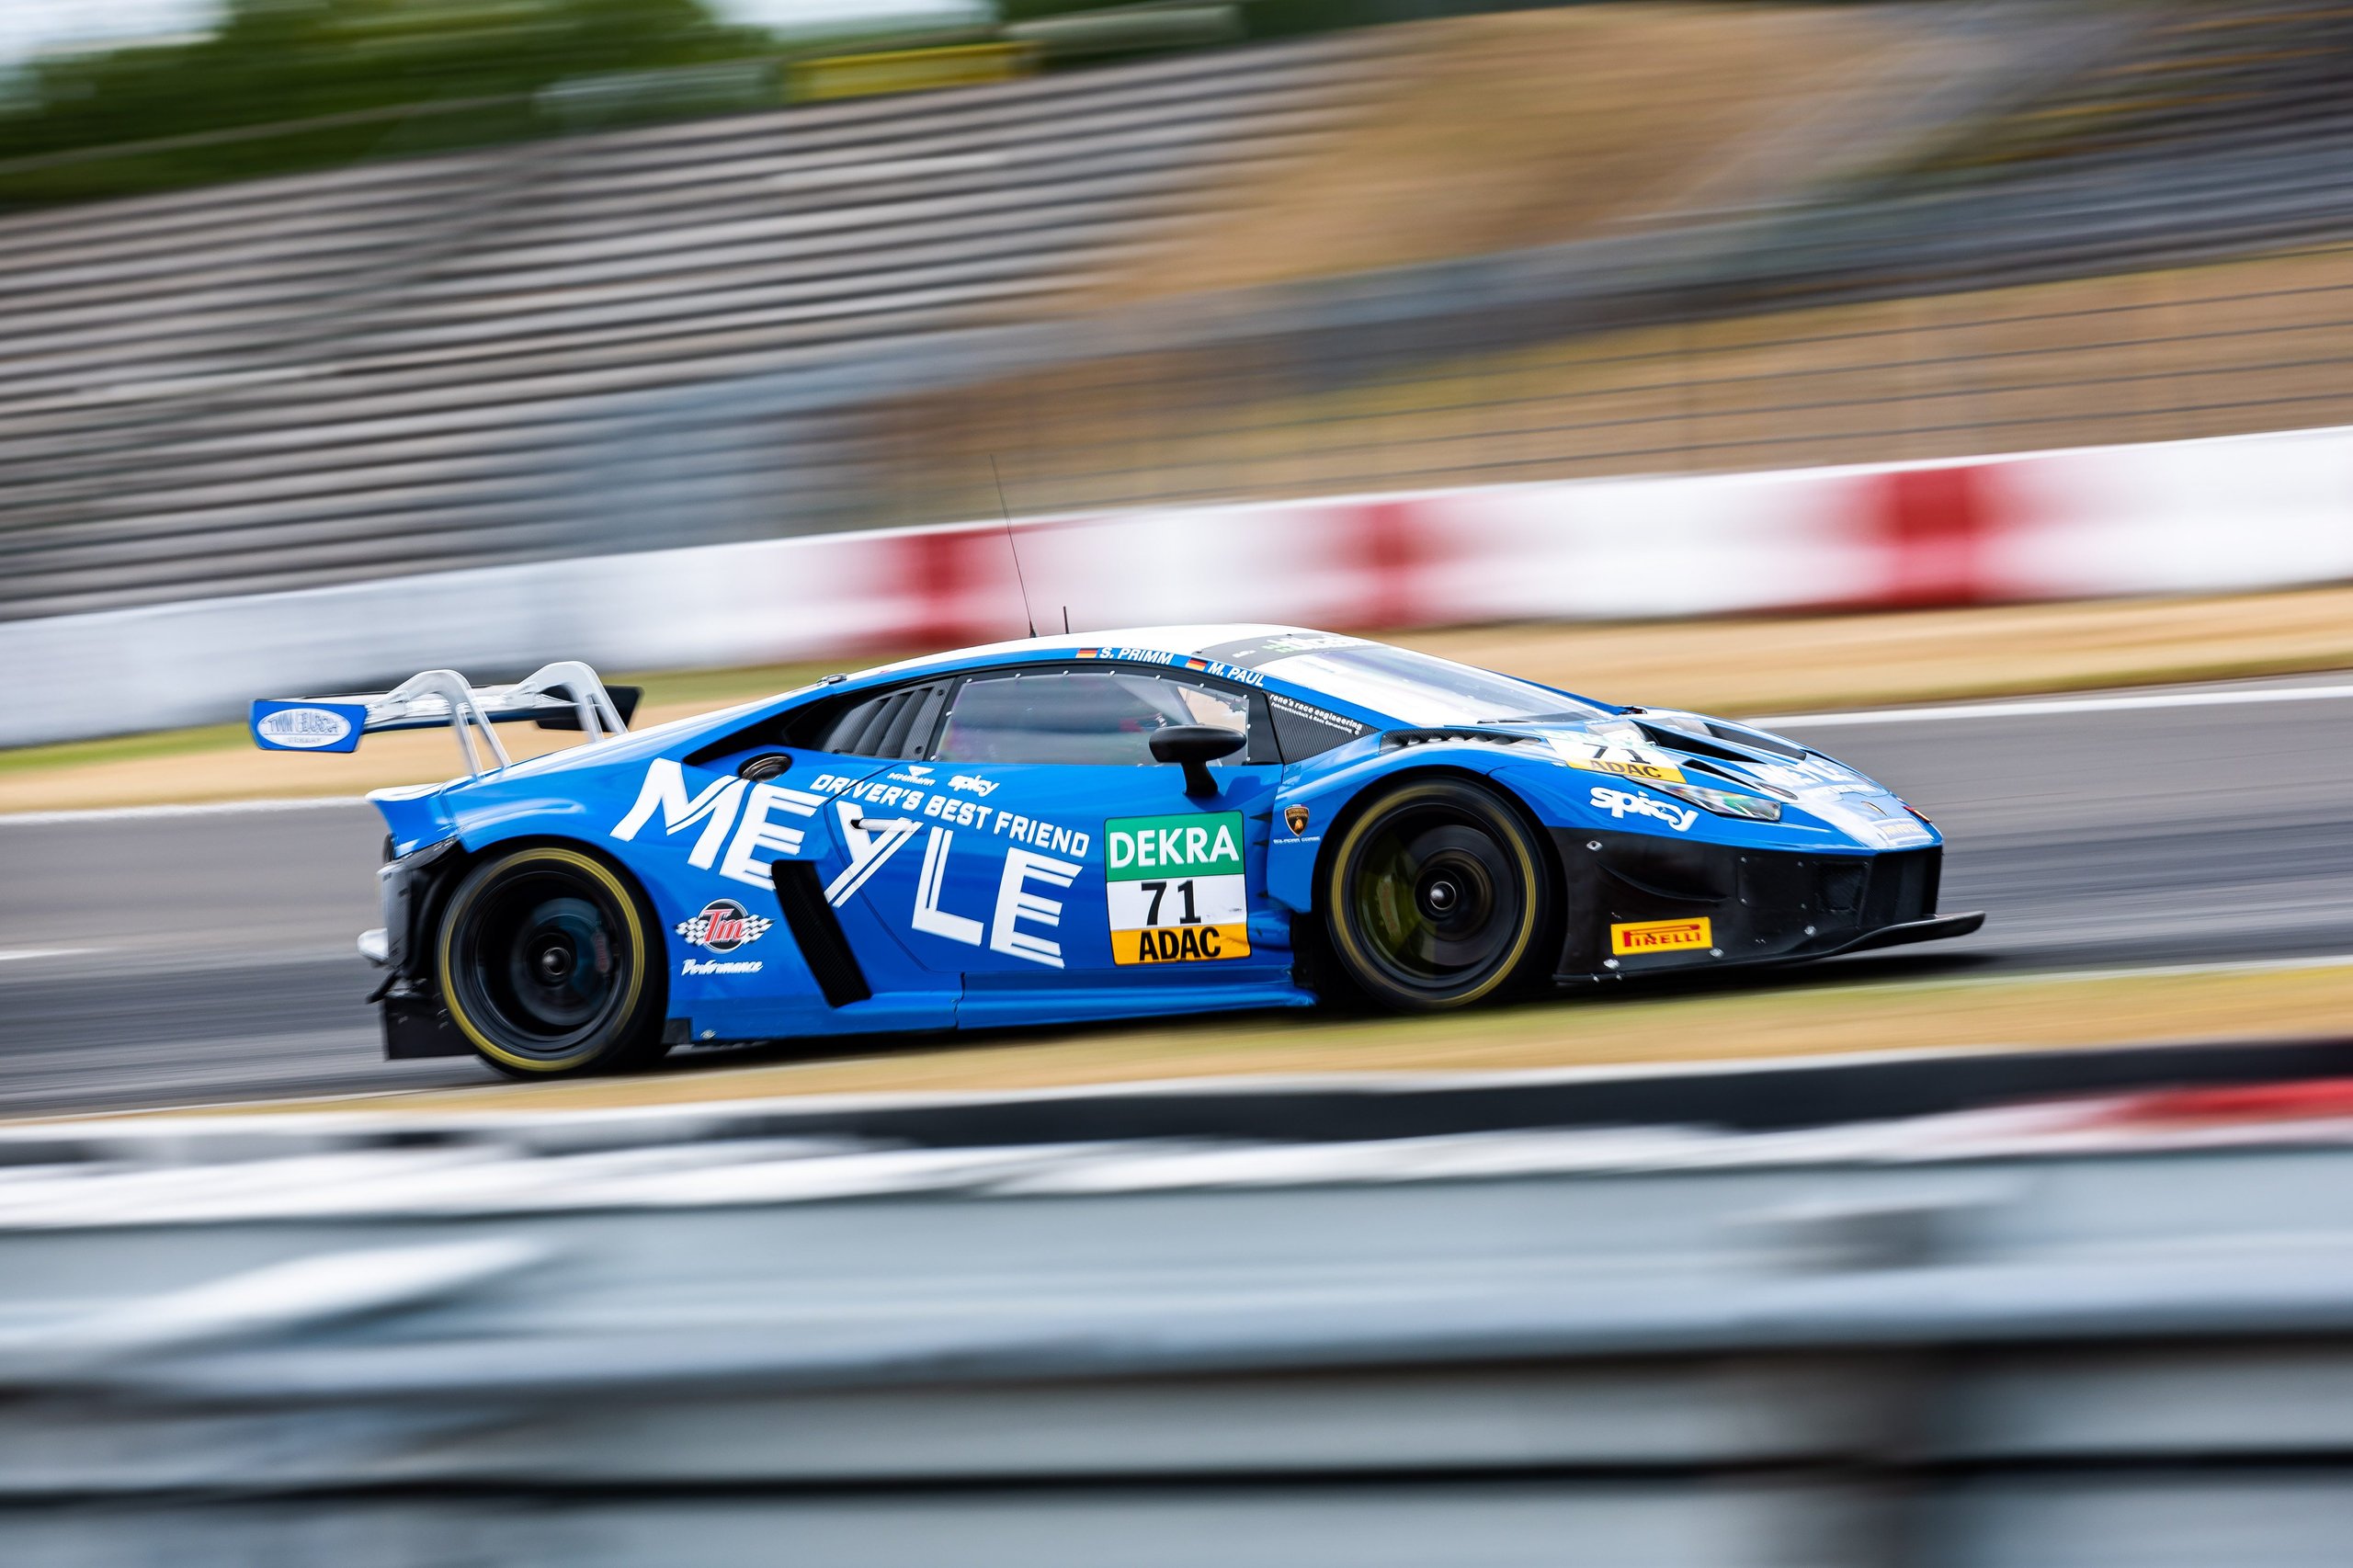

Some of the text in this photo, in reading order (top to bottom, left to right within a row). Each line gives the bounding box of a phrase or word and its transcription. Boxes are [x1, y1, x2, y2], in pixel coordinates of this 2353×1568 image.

[1099, 647, 1175, 665] S. PRIMM
[1208, 662, 1265, 687] M. PAUL
[1294, 701, 1314, 714] race
[1314, 708, 1363, 730] engineering
[1583, 743, 1651, 765] 71
[1589, 759, 1662, 778] ADAC
[810, 774, 1090, 858] DRIVER'S BEST FRIEND
[1589, 787, 1699, 832] spicy
[1109, 824, 1240, 869] DEKRA
[609, 757, 1083, 969] MEYLE
[1141, 880, 1201, 926] 71
[1139, 926, 1222, 962] ADAC
[1622, 924, 1700, 948] PIRELLI
